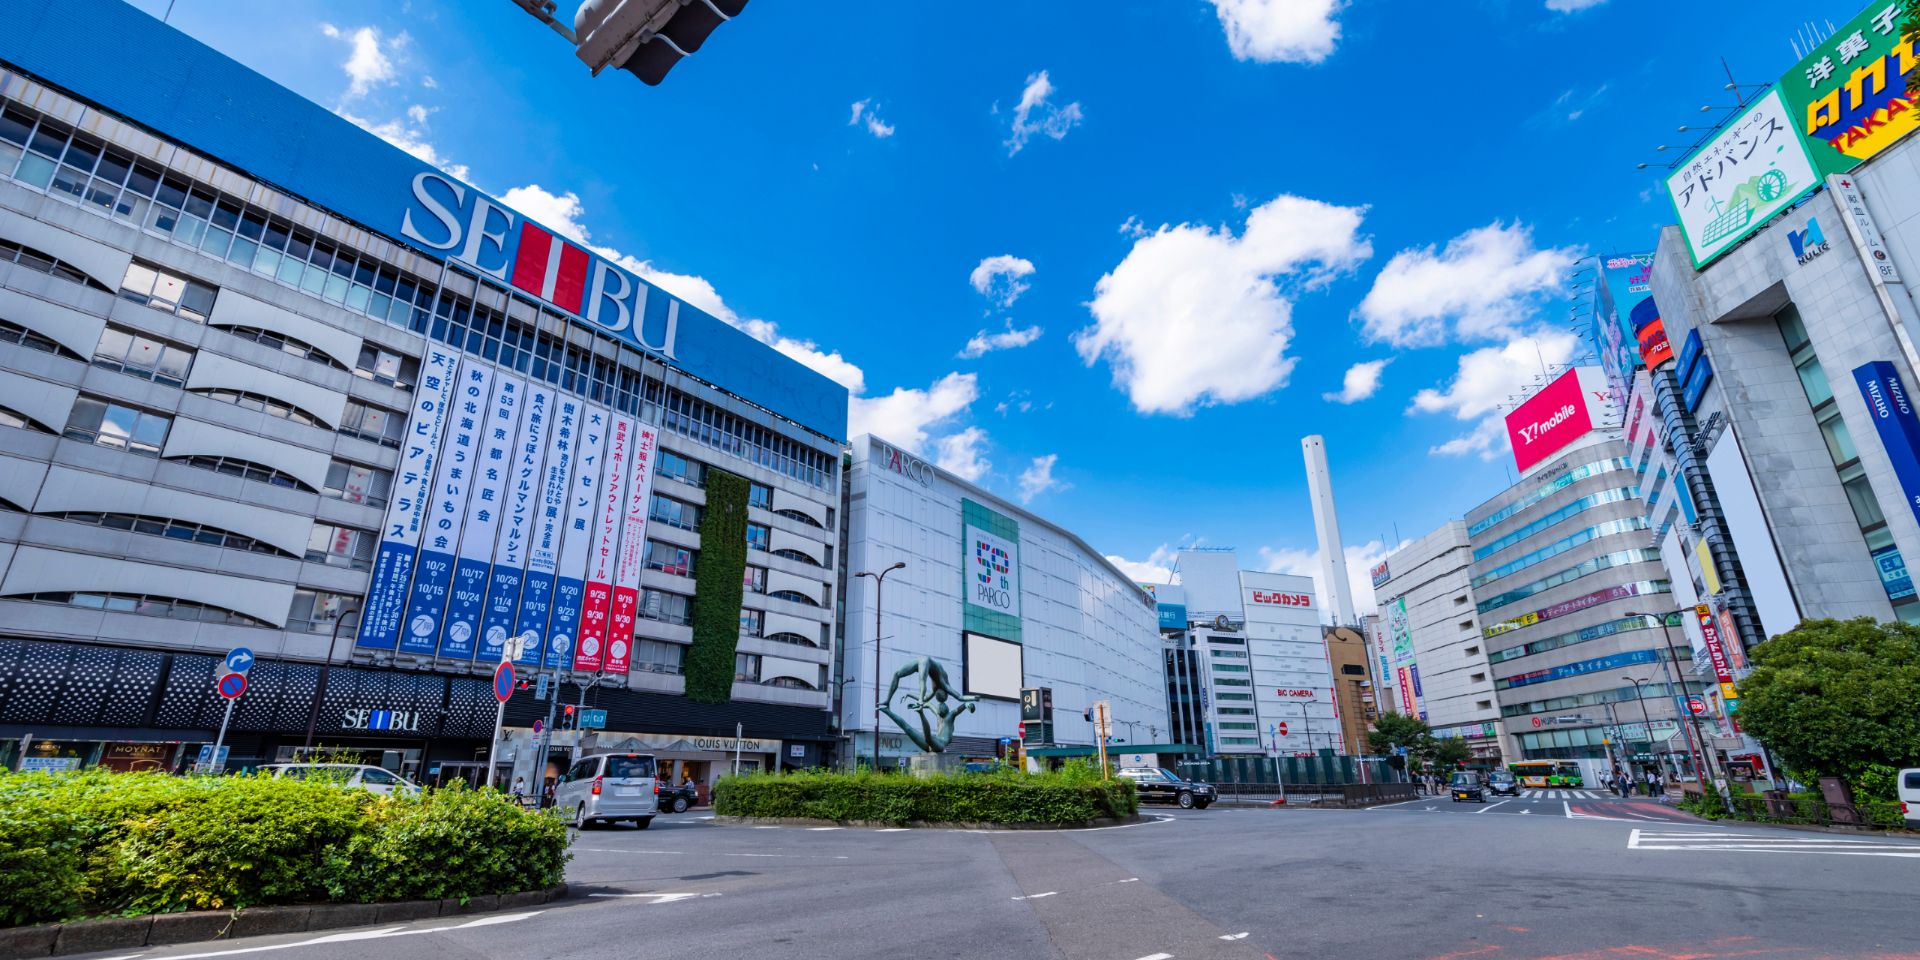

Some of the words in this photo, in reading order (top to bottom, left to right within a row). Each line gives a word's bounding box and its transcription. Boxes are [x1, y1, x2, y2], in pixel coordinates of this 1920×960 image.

[1805, 3, 1901, 89] 洋菓子
[1807, 32, 1920, 136] タカセ
[1683, 111, 1763, 183] 自然エネルギーの
[1678, 117, 1784, 208] アドバンス
[1847, 194, 1879, 247] 献血ルーム
[1798, 243, 1831, 266] HULIC
[400, 172, 679, 362] SEIBU
[1879, 265, 1893, 276] 8F
[1650, 341, 1670, 354] プロミ
[499, 382, 515, 421] 第53回
[1866, 379, 1889, 419] MIZUHO
[1887, 376, 1910, 415] MIZUHO
[556, 401, 576, 453] 樹木希林
[390, 351, 447, 539] 天空のビアテラス
[434, 370, 484, 549] 秋の北海道うまいもの会
[882, 444, 935, 489] PARCO
[477, 427, 508, 523] 京都名匠会
[506, 392, 546, 564] 食べ旅にっぽんグルマンマルシェ
[573, 413, 602, 531] 大マイセン展
[631, 430, 651, 515] 紳士服大バーゲン
[596, 420, 628, 580] 西武スポーツアウトレットセール
[425, 560, 447, 572] 10/2
[461, 567, 485, 580] 10/17
[417, 583, 445, 596] 10/15
[496, 574, 518, 586] 10/26
[531, 579, 548, 590] 10/2
[560, 585, 579, 596] 9/20
[456, 590, 480, 603] 10/24
[494, 596, 512, 607] 11/4
[590, 589, 607, 600] 9/25
[617, 594, 633, 604] 9/19
[977, 583, 1010, 609] PARCO
[1252, 590, 1310, 607] ビックカメラ
[525, 601, 546, 612] 10/15
[557, 606, 575, 617] 9/23
[586, 609, 604, 620] 9/30
[614, 614, 631, 624] 9/30
[1557, 658, 1619, 675] アートネイチャー
[1631, 652, 1645, 661] 4F
[1277, 688, 1288, 697] BIC
[1289, 689, 1314, 698] CAMERA
[342, 708, 419, 732] SEIBU
[115, 745, 161, 754] MOYNAT
[694, 738, 720, 749] LOUIS
